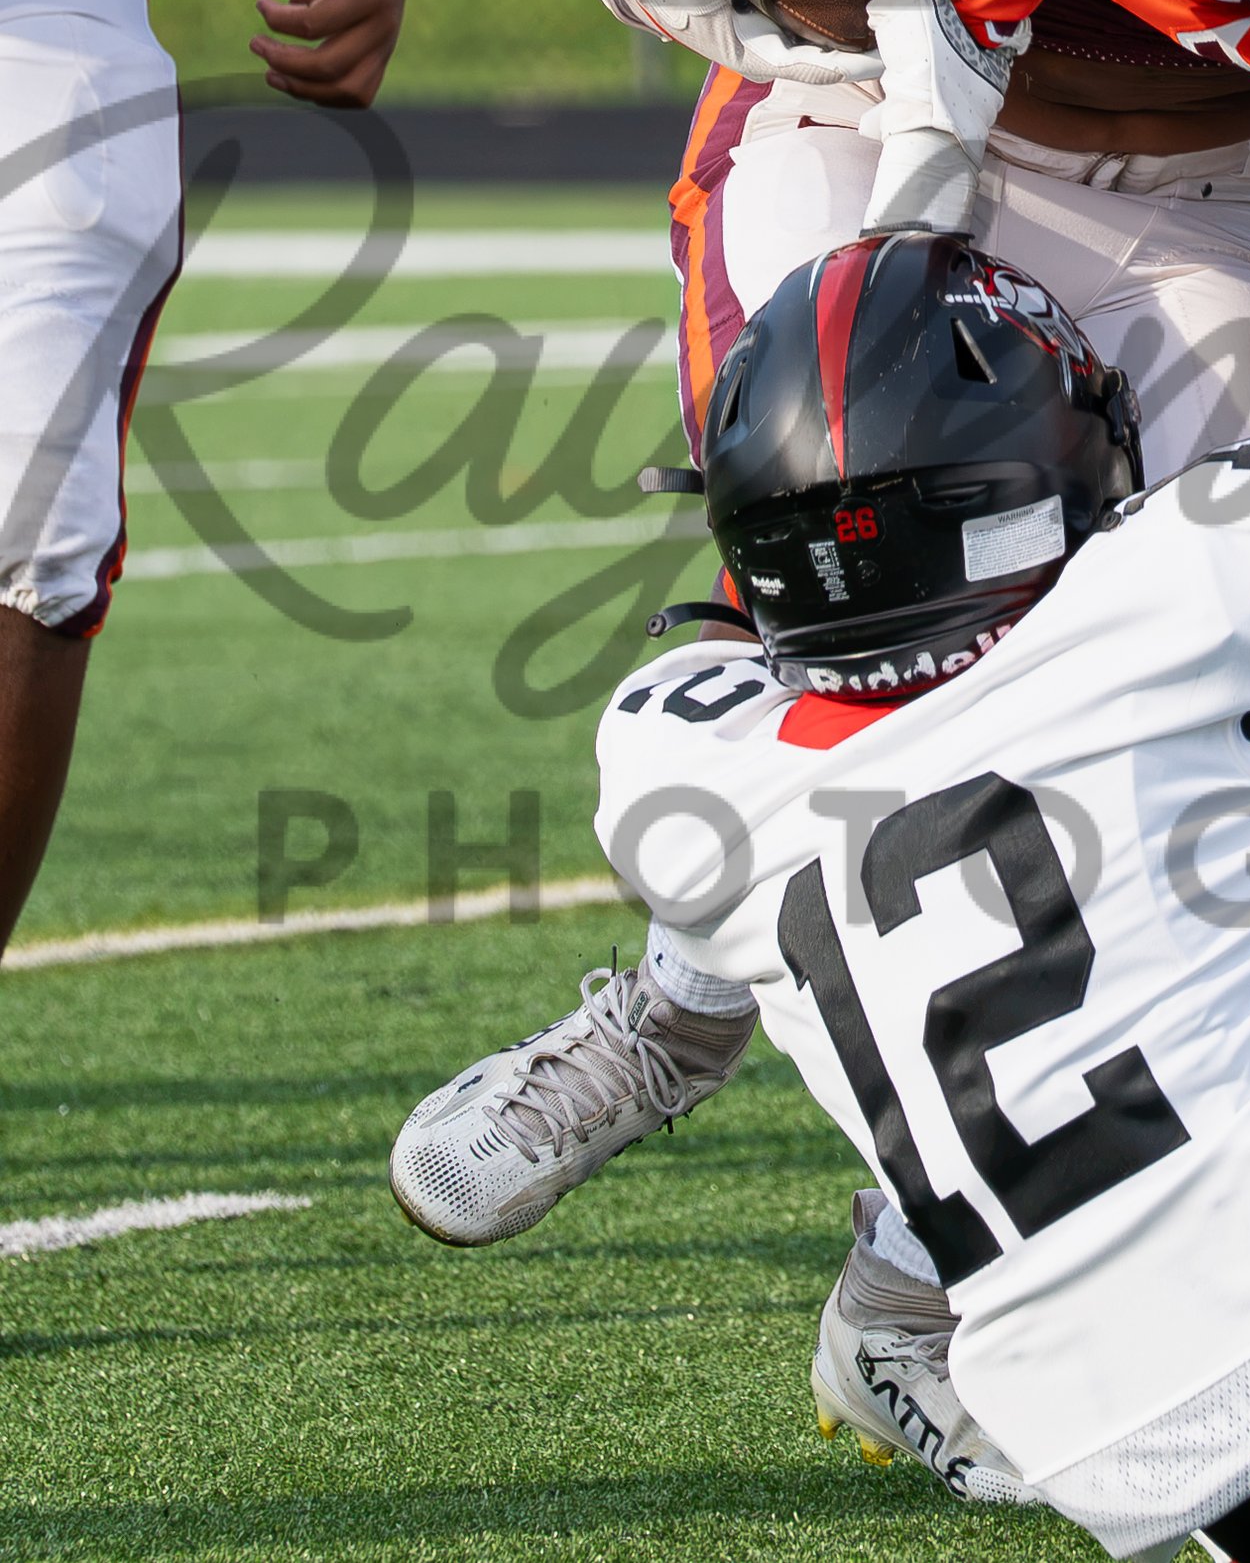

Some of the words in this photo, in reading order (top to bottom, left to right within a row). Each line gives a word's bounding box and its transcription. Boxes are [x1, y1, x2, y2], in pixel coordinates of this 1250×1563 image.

[835, 506, 878, 543] 26
[997, 504, 1035, 524] WARNING
[777, 770, 1192, 1289] 12
[855, 1343, 976, 1500] BATTLE
